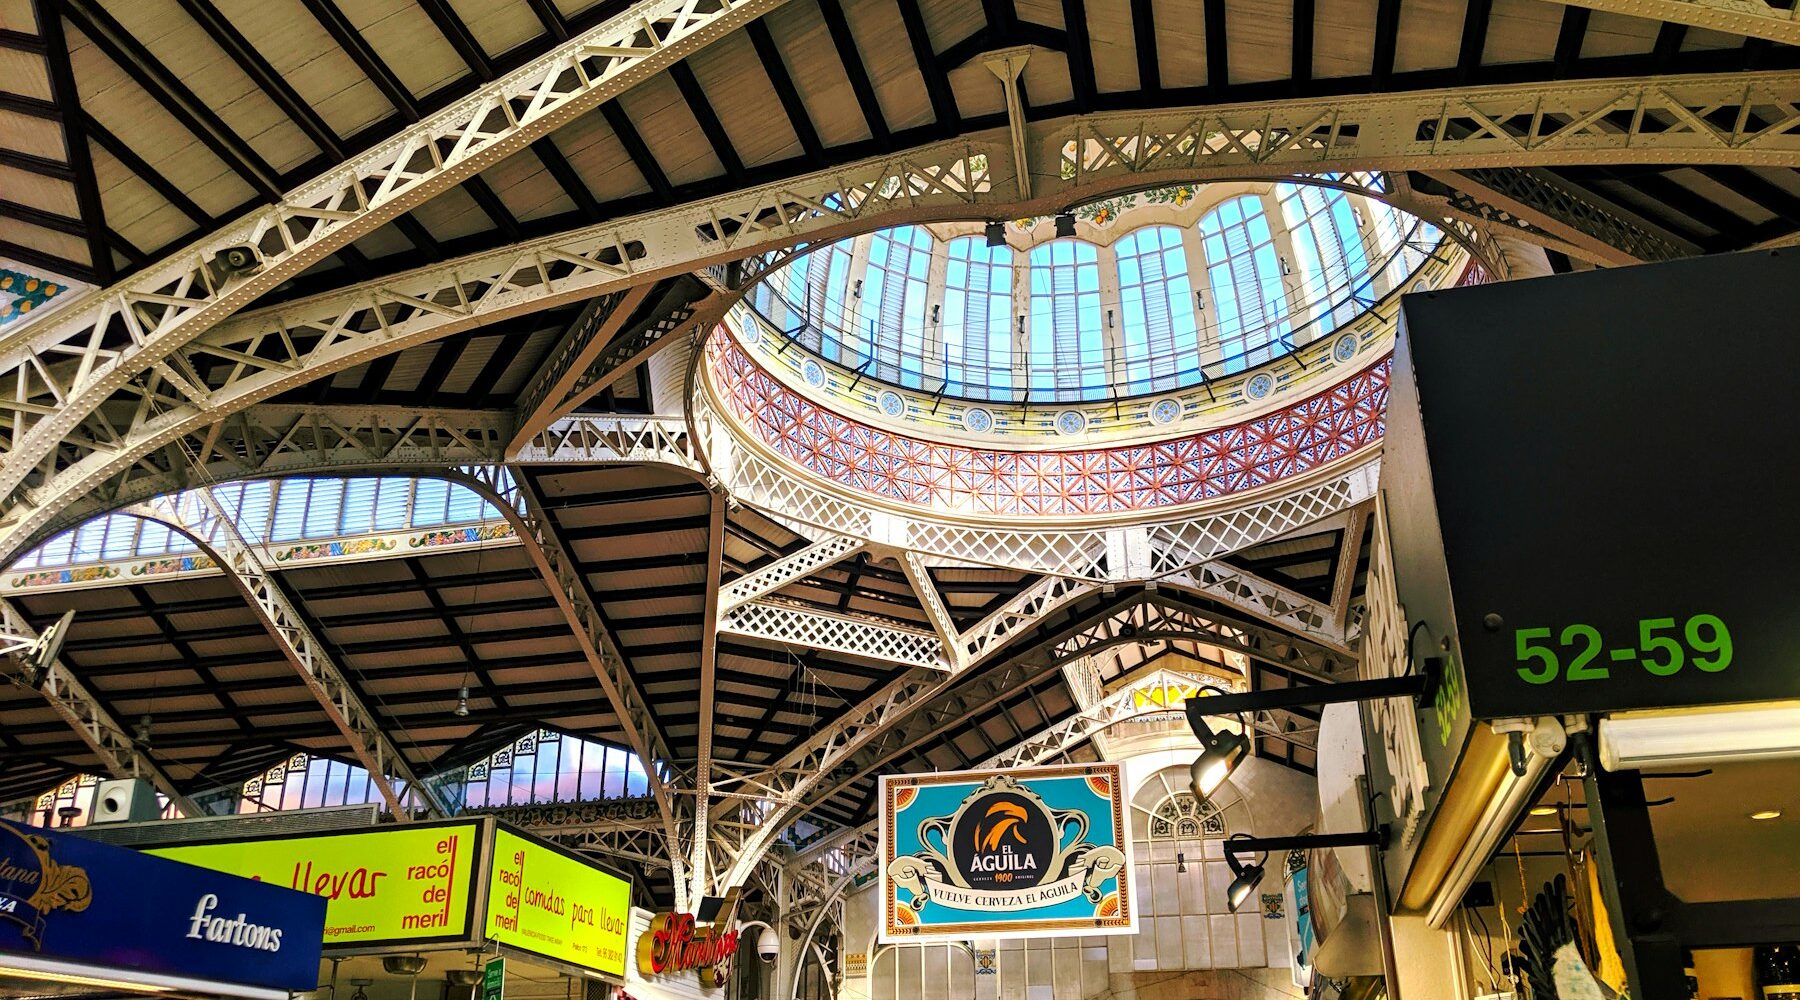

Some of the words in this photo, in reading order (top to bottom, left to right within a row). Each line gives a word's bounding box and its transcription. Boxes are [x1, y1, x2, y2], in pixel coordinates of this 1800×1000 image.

[1515, 613, 1734, 685] 52-59
[1002, 845, 1013, 854] EL
[407, 859, 449, 880] racó
[970, 853, 1037, 872] ÁGUILA
[499, 868, 519, 887] racó
[995, 872, 1013, 883] 1900
[422, 884, 446, 903] de
[506, 891, 518, 909] de
[934, 888, 971, 904] VUELVE
[975, 896, 1022, 907] CERVEZA
[1026, 894, 1037, 904] EL
[1040, 882, 1078, 900] AGUILA
[525, 886, 565, 916] comidas
[572, 902, 594, 931] para
[600, 906, 624, 936] llevar
[186, 893, 282, 952] fartons
